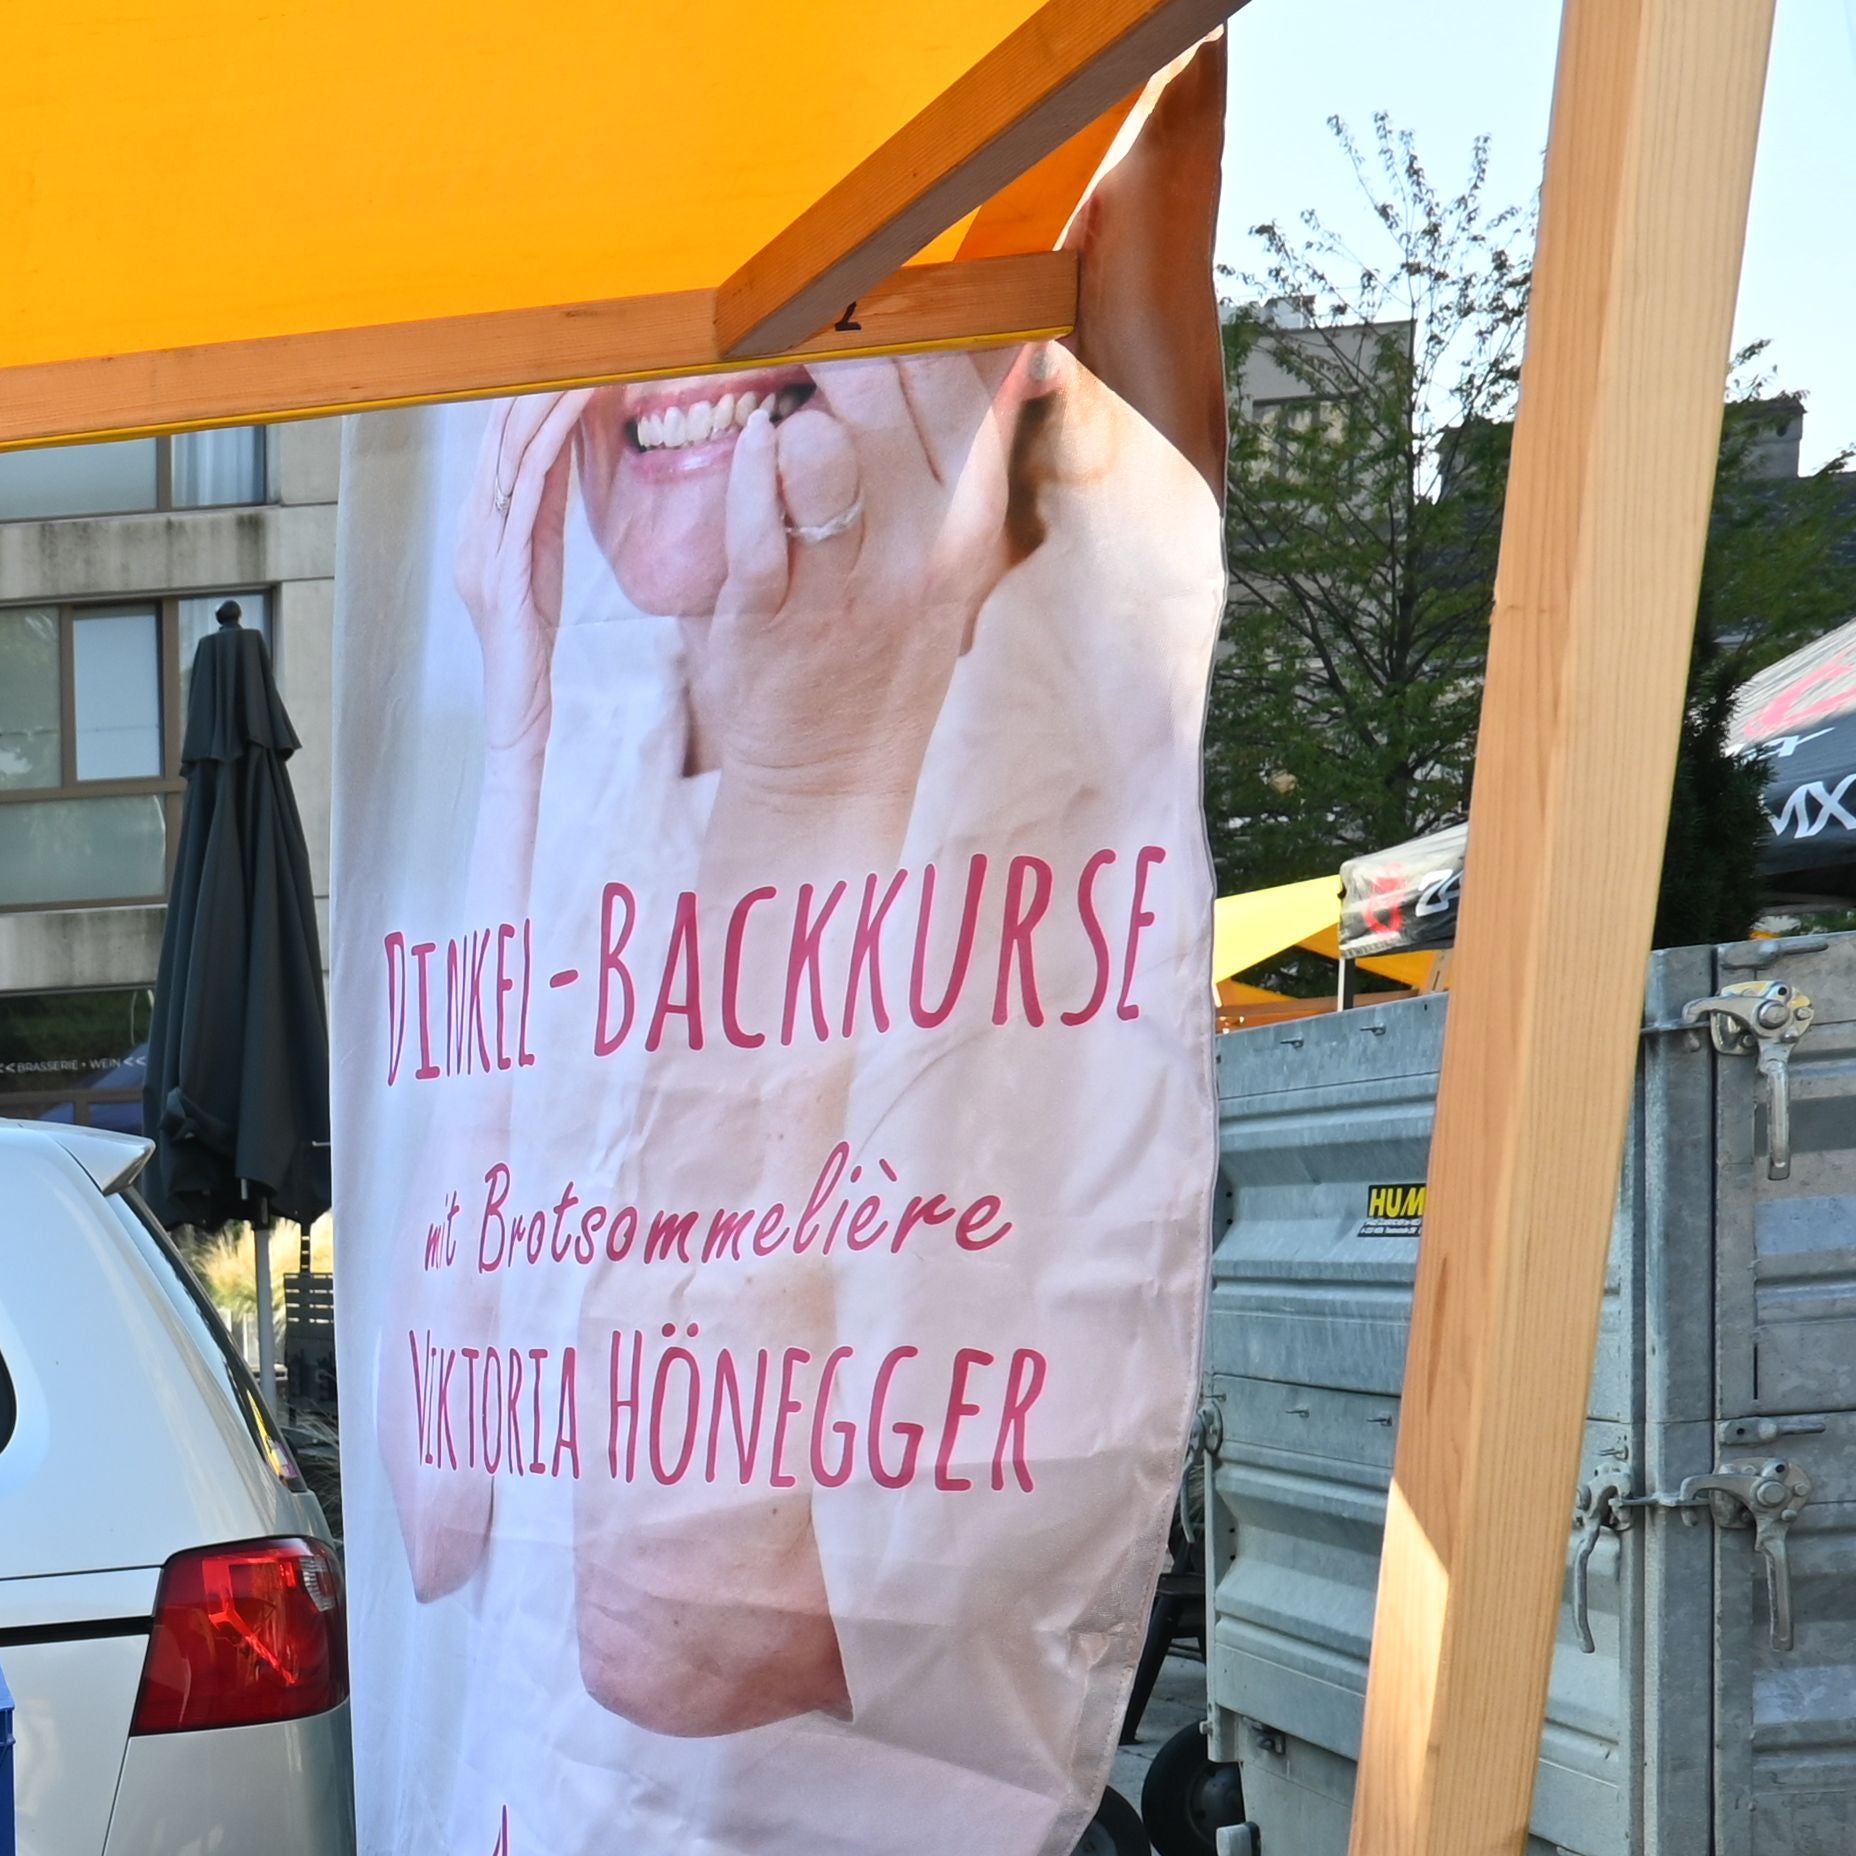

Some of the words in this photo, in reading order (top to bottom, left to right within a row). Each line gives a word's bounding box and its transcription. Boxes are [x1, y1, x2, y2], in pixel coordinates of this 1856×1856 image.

[383, 845, 1168, 1088] DINKEL-BACKKURSE
[16, 1059, 79, 1073] BRASSERIE
[88, 1056, 121, 1069] WEIN
[423, 1189, 458, 1272] mit
[477, 1140, 1014, 1274] Brotsommelière
[407, 1329, 580, 1480] VIKTORIA
[608, 1322, 1048, 1494] HÖNEGGER
